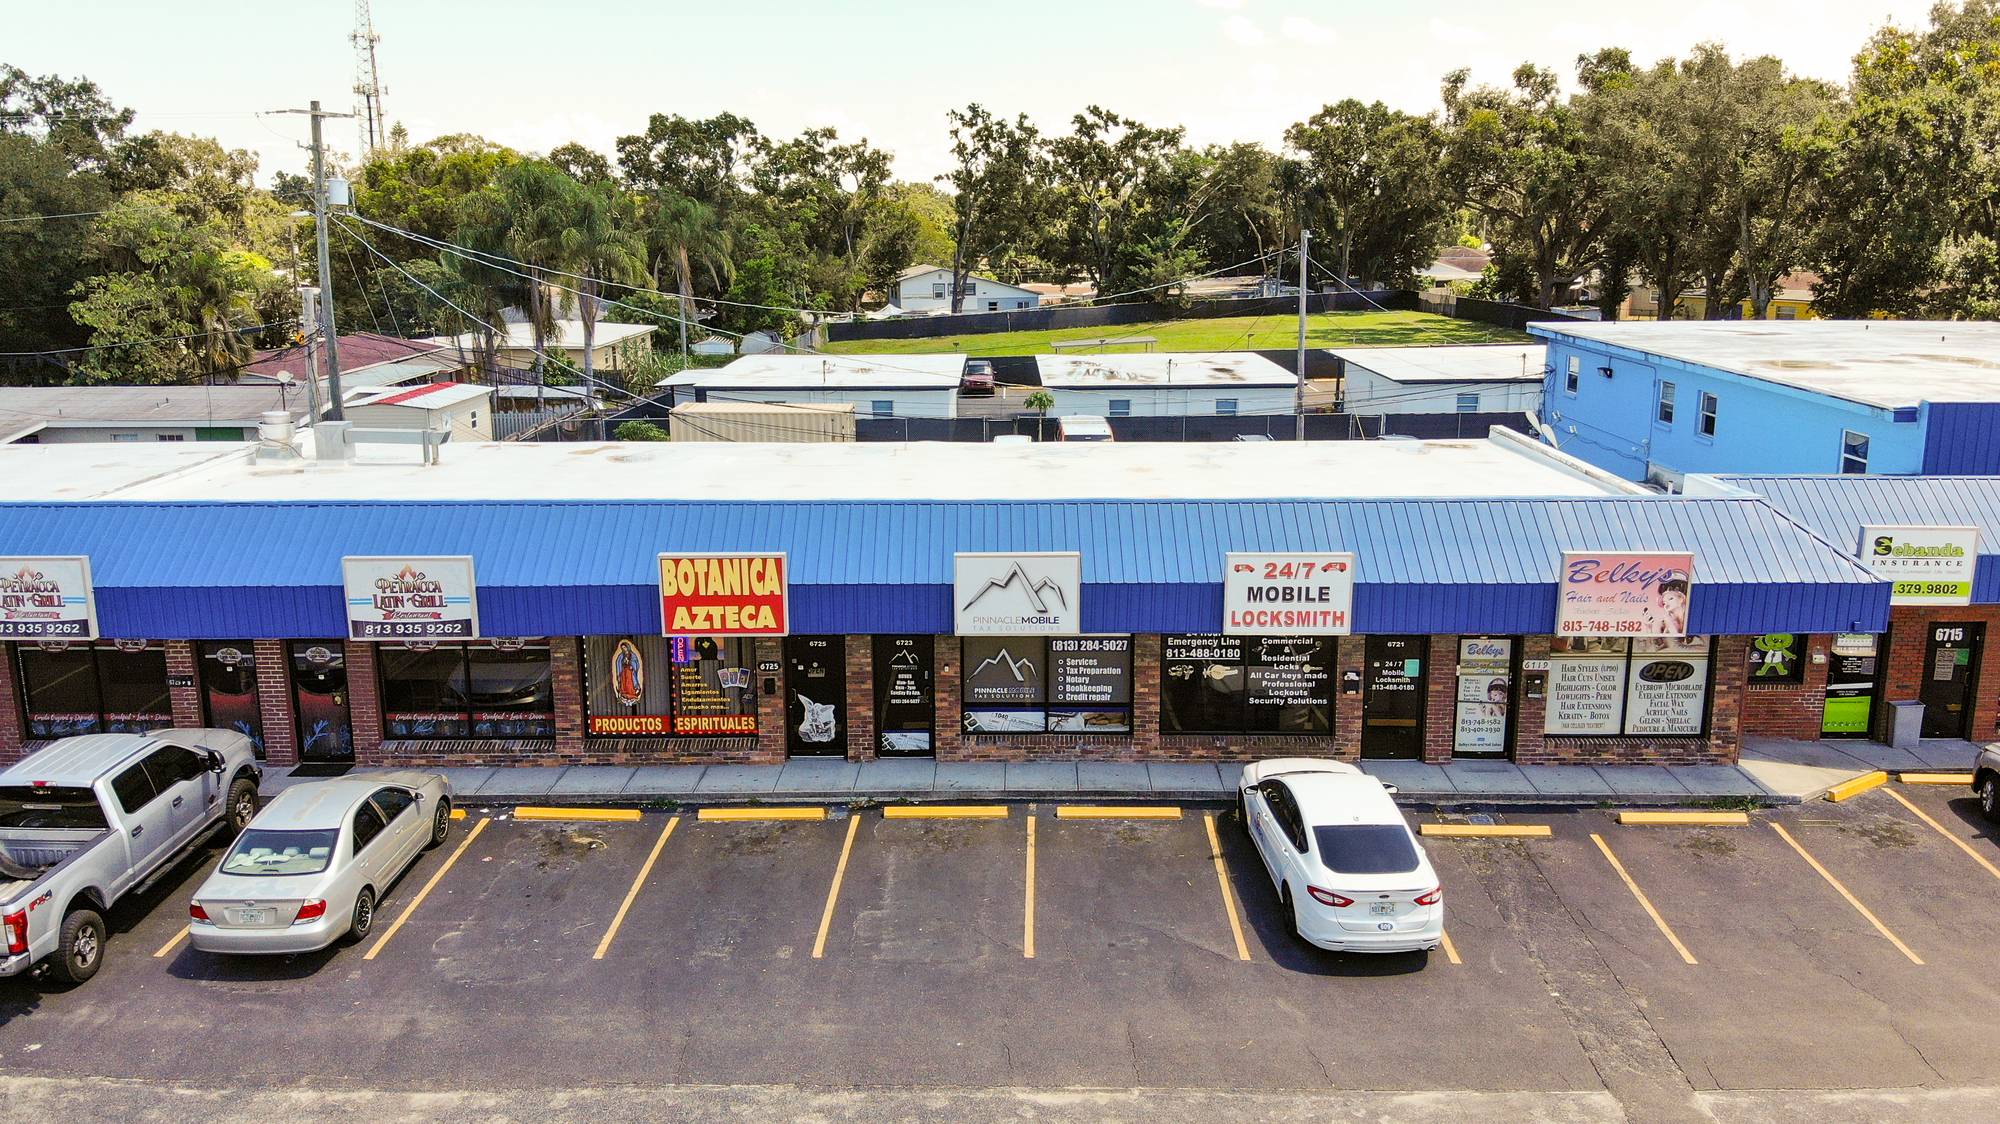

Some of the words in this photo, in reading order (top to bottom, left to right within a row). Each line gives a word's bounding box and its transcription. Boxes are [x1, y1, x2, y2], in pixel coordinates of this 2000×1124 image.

[1873, 536, 1964, 557] Sebanda
[1264, 562, 1316, 580] 24/7
[661, 558, 781, 597] BOTANICA
[1247, 586, 1330, 603] MOBILE
[1566, 590, 1592, 603] Hair
[1596, 592, 1618, 603] and
[1619, 590, 1649, 603] Nails
[27, 593, 66, 608] GRILL
[372, 594, 405, 613] LATIN
[406, 593, 448, 608] GRILL
[672, 605, 777, 630] AZTECA
[1231, 610, 1345, 627] LOCKSMITH
[0, 624, 13, 633] 13
[18, 624, 42, 633] 935
[46, 624, 80, 633] 9262
[365, 624, 391, 634] 813
[396, 624, 422, 633] 935
[426, 624, 462, 633] 9262
[1562, 620, 1642, 632] 813-748-1582
[1935, 628, 1963, 641] 6715
[1052, 640, 1078, 651] (813)
[1080, 640, 1128, 651] 284-5027
[1168, 637, 1219, 647] Emergency
[1221, 637, 1240, 645] Line
[1261, 637, 1313, 645] Commercial
[1166, 648, 1240, 658] 813-488-0180
[1261, 654, 1310, 662] Residential
[1066, 658, 1098, 666] Services
[1079, 667, 1121, 675] Preparation
[1561, 664, 1576, 672] HAIR
[1577, 664, 1599, 672] STYLES
[1643, 663, 1689, 679] OPEN
[1065, 676, 1090, 684] Notary
[1281, 672, 1302, 680] keys
[1561, 673, 1576, 681] HAIR
[1065, 684, 1113, 693] Bookkeeping
[1555, 683, 1591, 691] HIGHLIGHTS
[1596, 683, 1617, 691] COLOR
[1635, 682, 1663, 691] EYEBROW
[1065, 693, 1088, 701] Credit
[1089, 693, 1111, 702] repair
[1268, 689, 1308, 697] Lockouts
[1556, 692, 1591, 700] LOWLIGHTS
[1595, 692, 1612, 700] PERM
[1249, 697, 1286, 706] Security
[1560, 702, 1576, 710] HAIR
[1577, 702, 1612, 710] EXTENSIONS
[595, 717, 662, 731] PRODUCTOS
[677, 716, 755, 730] ESPIRITUALES
